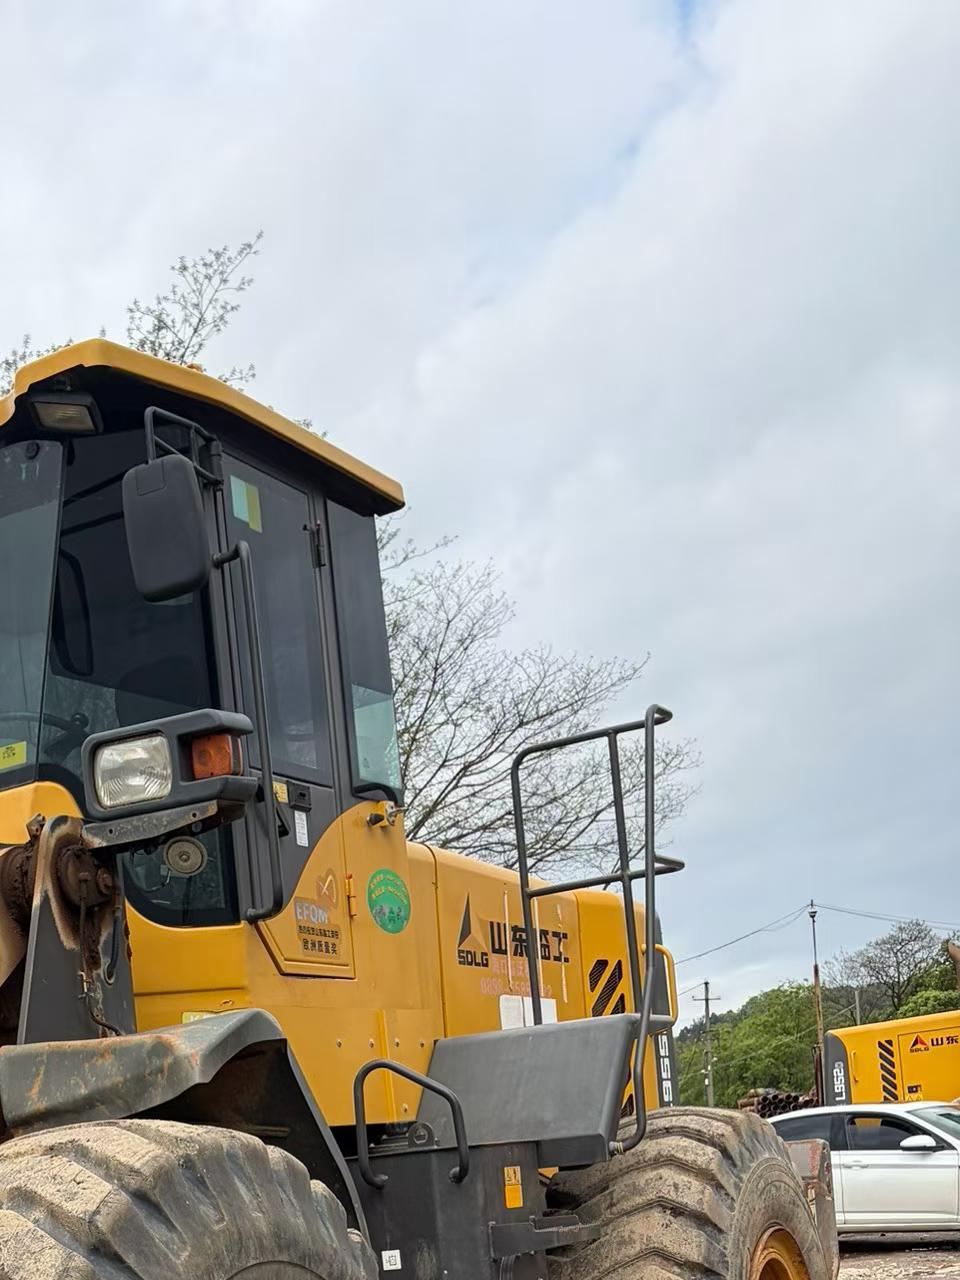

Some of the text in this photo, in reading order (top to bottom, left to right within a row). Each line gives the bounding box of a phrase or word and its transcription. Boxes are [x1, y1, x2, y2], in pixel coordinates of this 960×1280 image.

[295, 901, 329, 924] EFQM
[457, 949, 489, 968] SDLG
[930, 1034, 960, 1047] 山东
